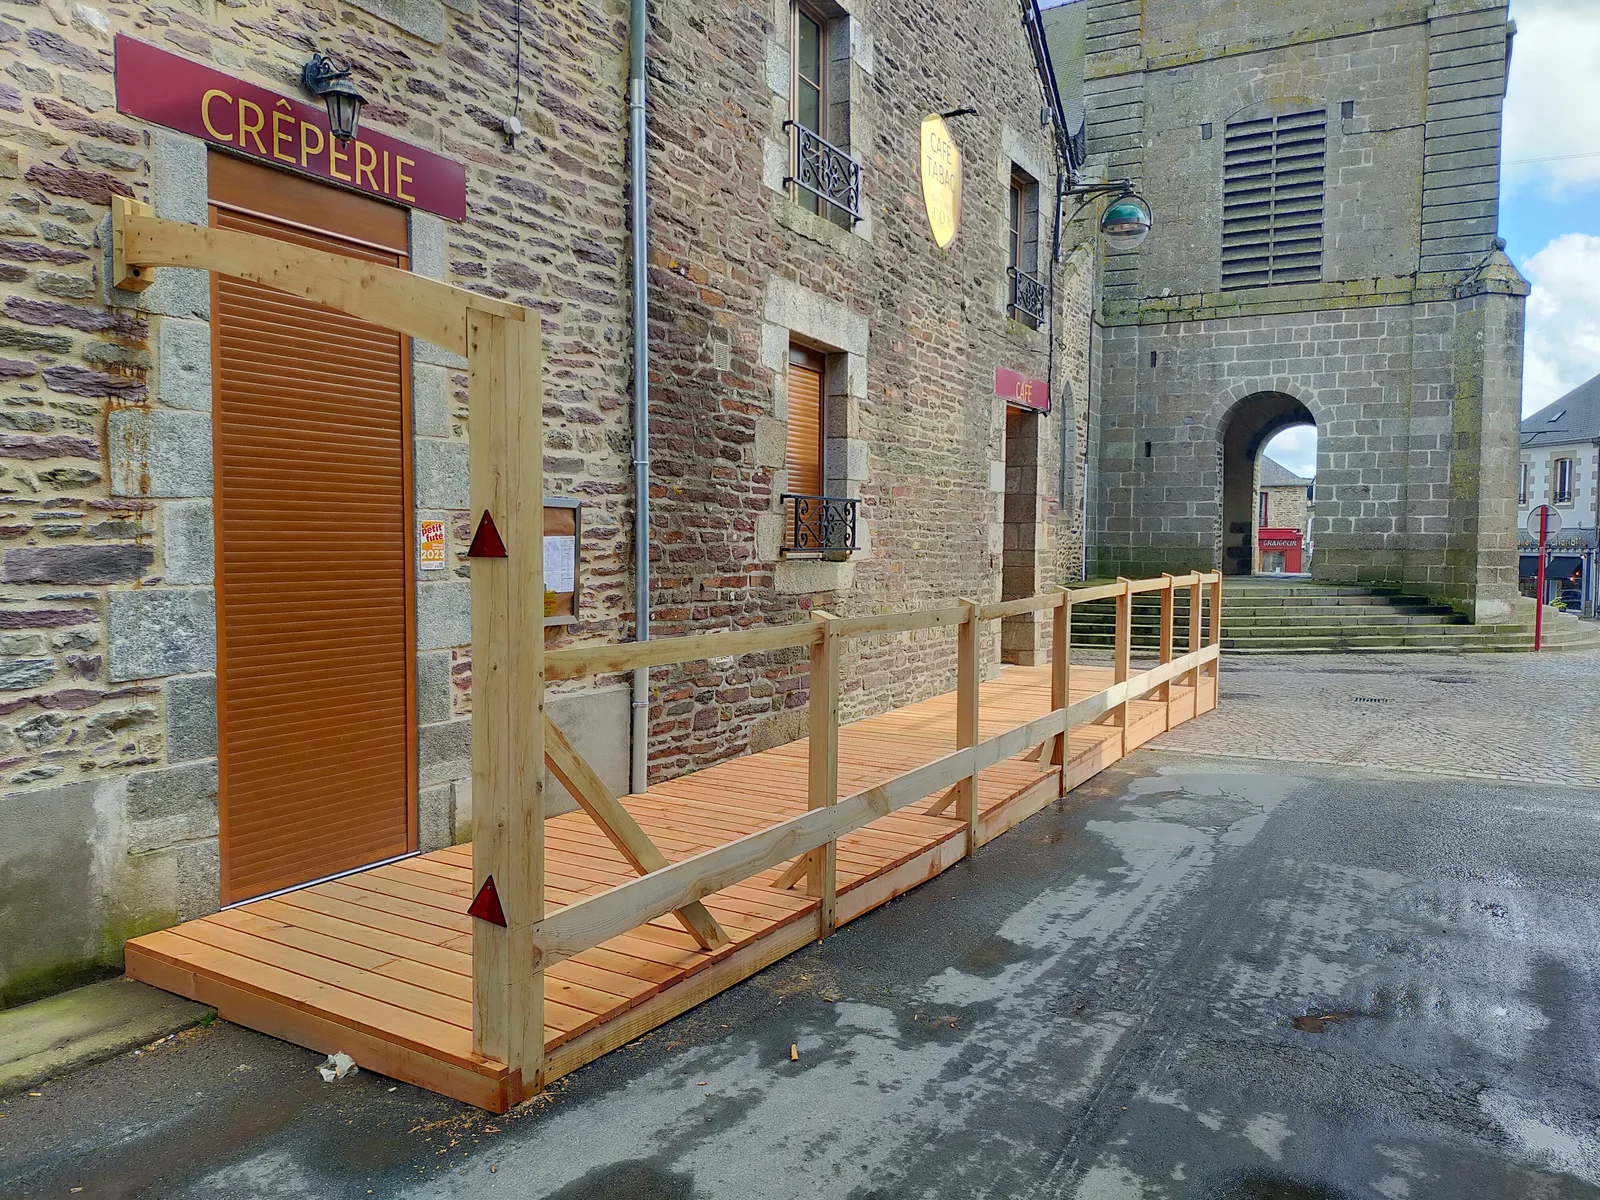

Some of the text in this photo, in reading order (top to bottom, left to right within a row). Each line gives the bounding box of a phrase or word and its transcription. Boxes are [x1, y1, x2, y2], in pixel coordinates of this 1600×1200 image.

[201, 88, 416, 203] CRÊPERIE
[930, 132, 952, 166] CAFÉ
[926, 155, 956, 194] TABAC
[1016, 381, 1032, 402] CAFÉ
[422, 524, 442, 536] petit
[421, 550, 444, 559] 2023
